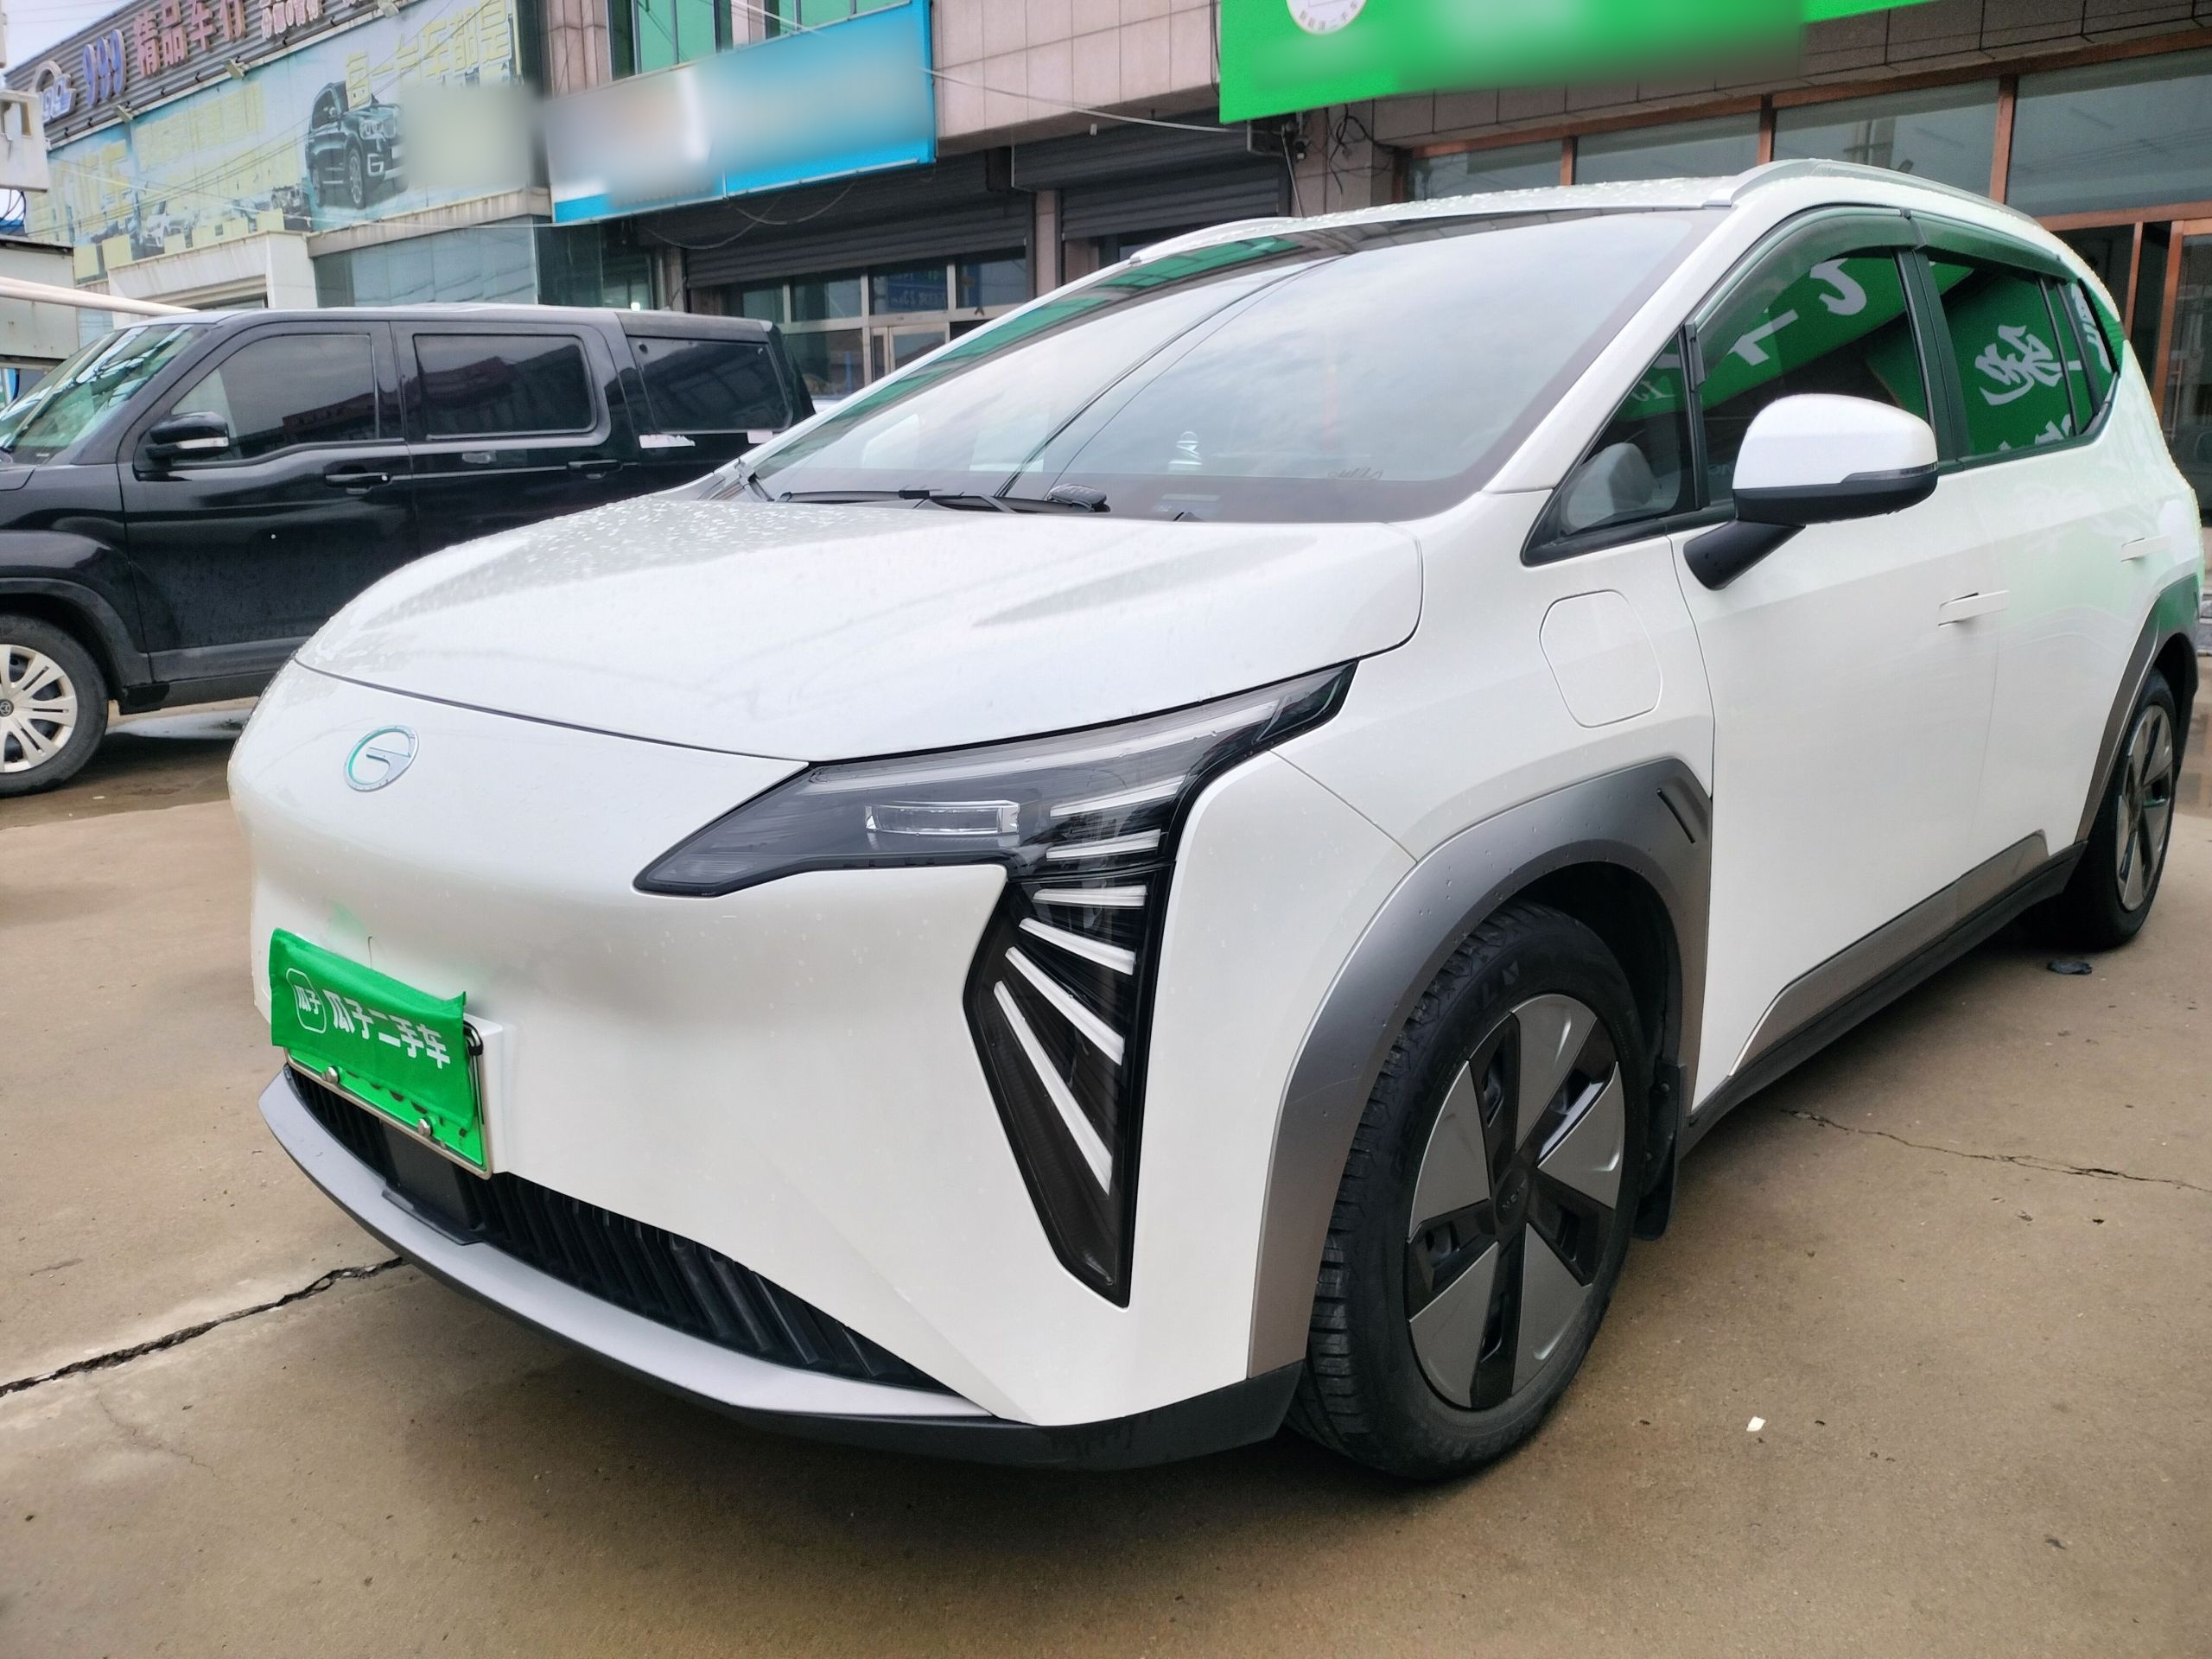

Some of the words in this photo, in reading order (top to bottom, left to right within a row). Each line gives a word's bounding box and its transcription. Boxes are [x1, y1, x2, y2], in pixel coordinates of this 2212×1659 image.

[293, 983, 321, 1015] 瓜子
[322, 988, 451, 1070] 瓜子二手车
